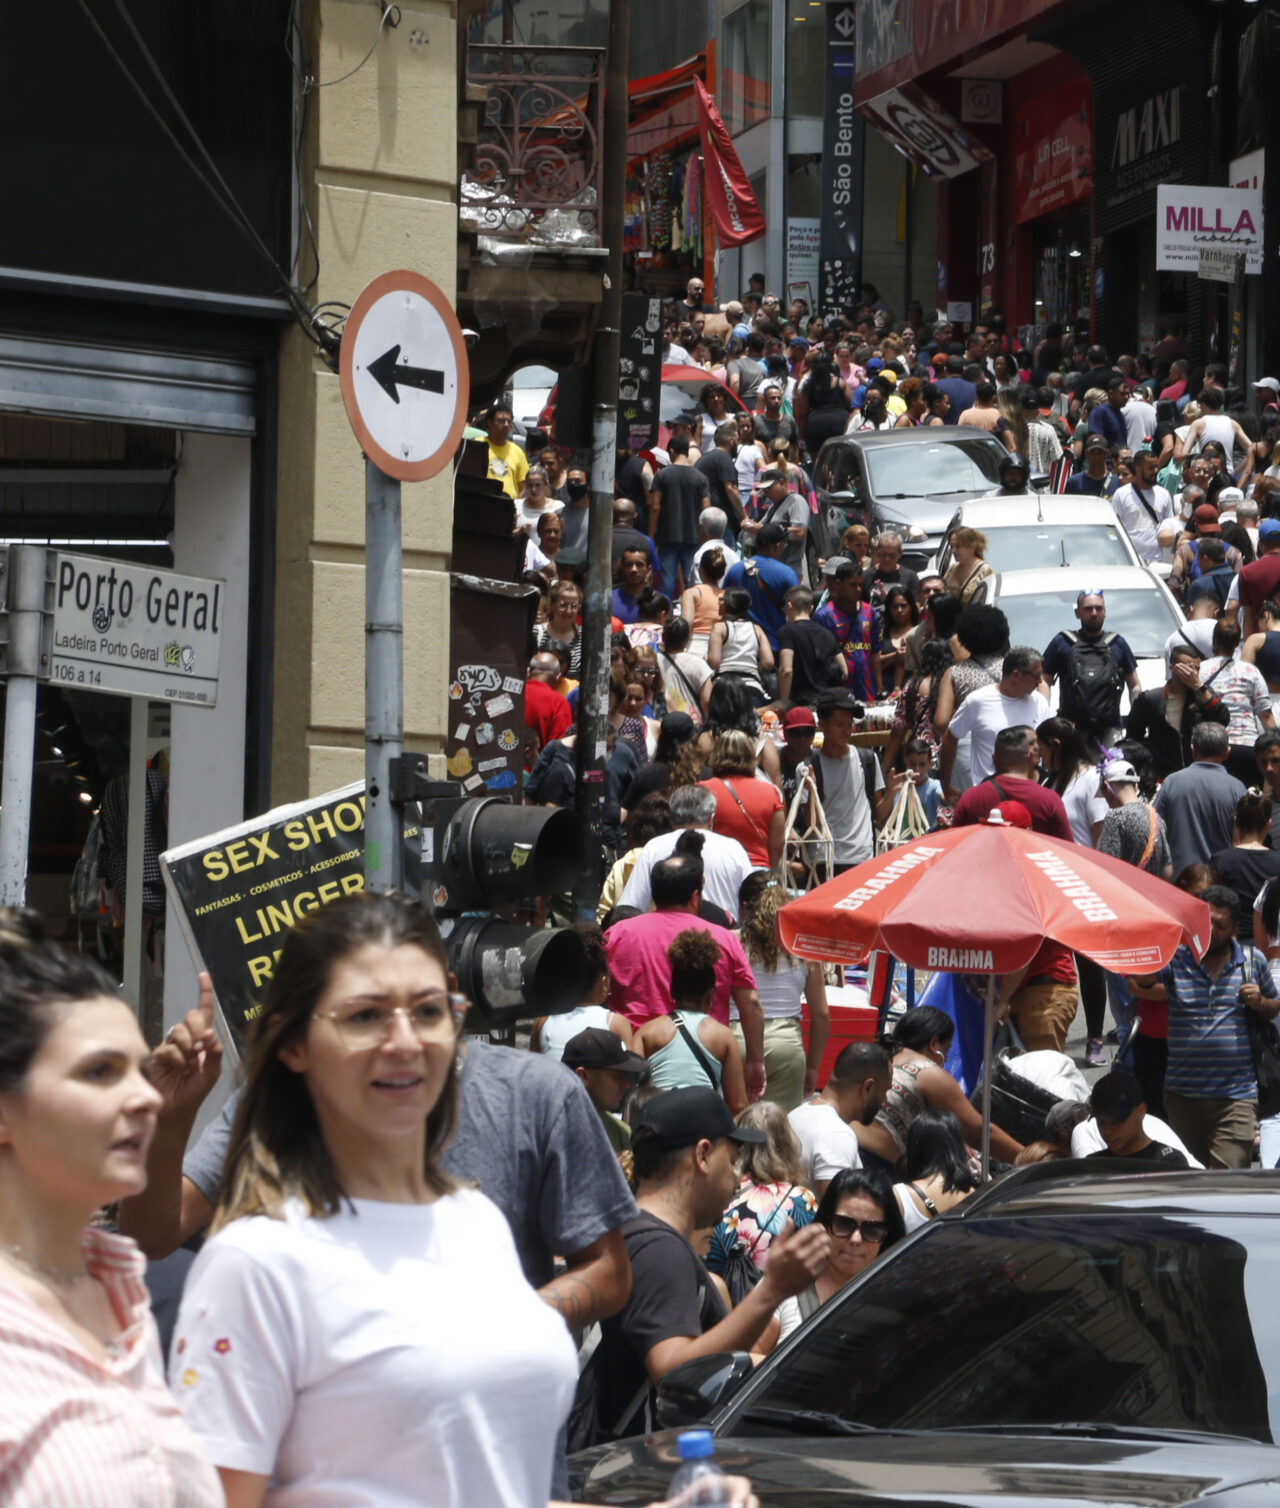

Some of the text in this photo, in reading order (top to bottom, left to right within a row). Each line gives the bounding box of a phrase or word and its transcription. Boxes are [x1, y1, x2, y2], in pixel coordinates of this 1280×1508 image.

[1110, 86, 1181, 172] MAXI
[833, 93, 854, 205] São Bento
[1166, 206, 1257, 234] MILLA
[1193, 229, 1257, 245] cabelos
[981, 242, 996, 275] 73
[58, 560, 220, 634] Porto Geral
[55, 631, 160, 662] Ladeira Porto Geral
[841, 641, 871, 653] akuten
[54, 664, 102, 684] 106 a 14
[165, 688, 177, 698] CEP
[202, 795, 366, 882] SEX SHO
[195, 893, 241, 917] FANTASIAS
[250, 870, 304, 896] COSMETICOS
[310, 848, 361, 874] ACESSORIOS
[833, 846, 945, 911] BRAHMA
[1025, 850, 1119, 923] BRAHMA
[927, 946, 994, 971] BRAHMA
